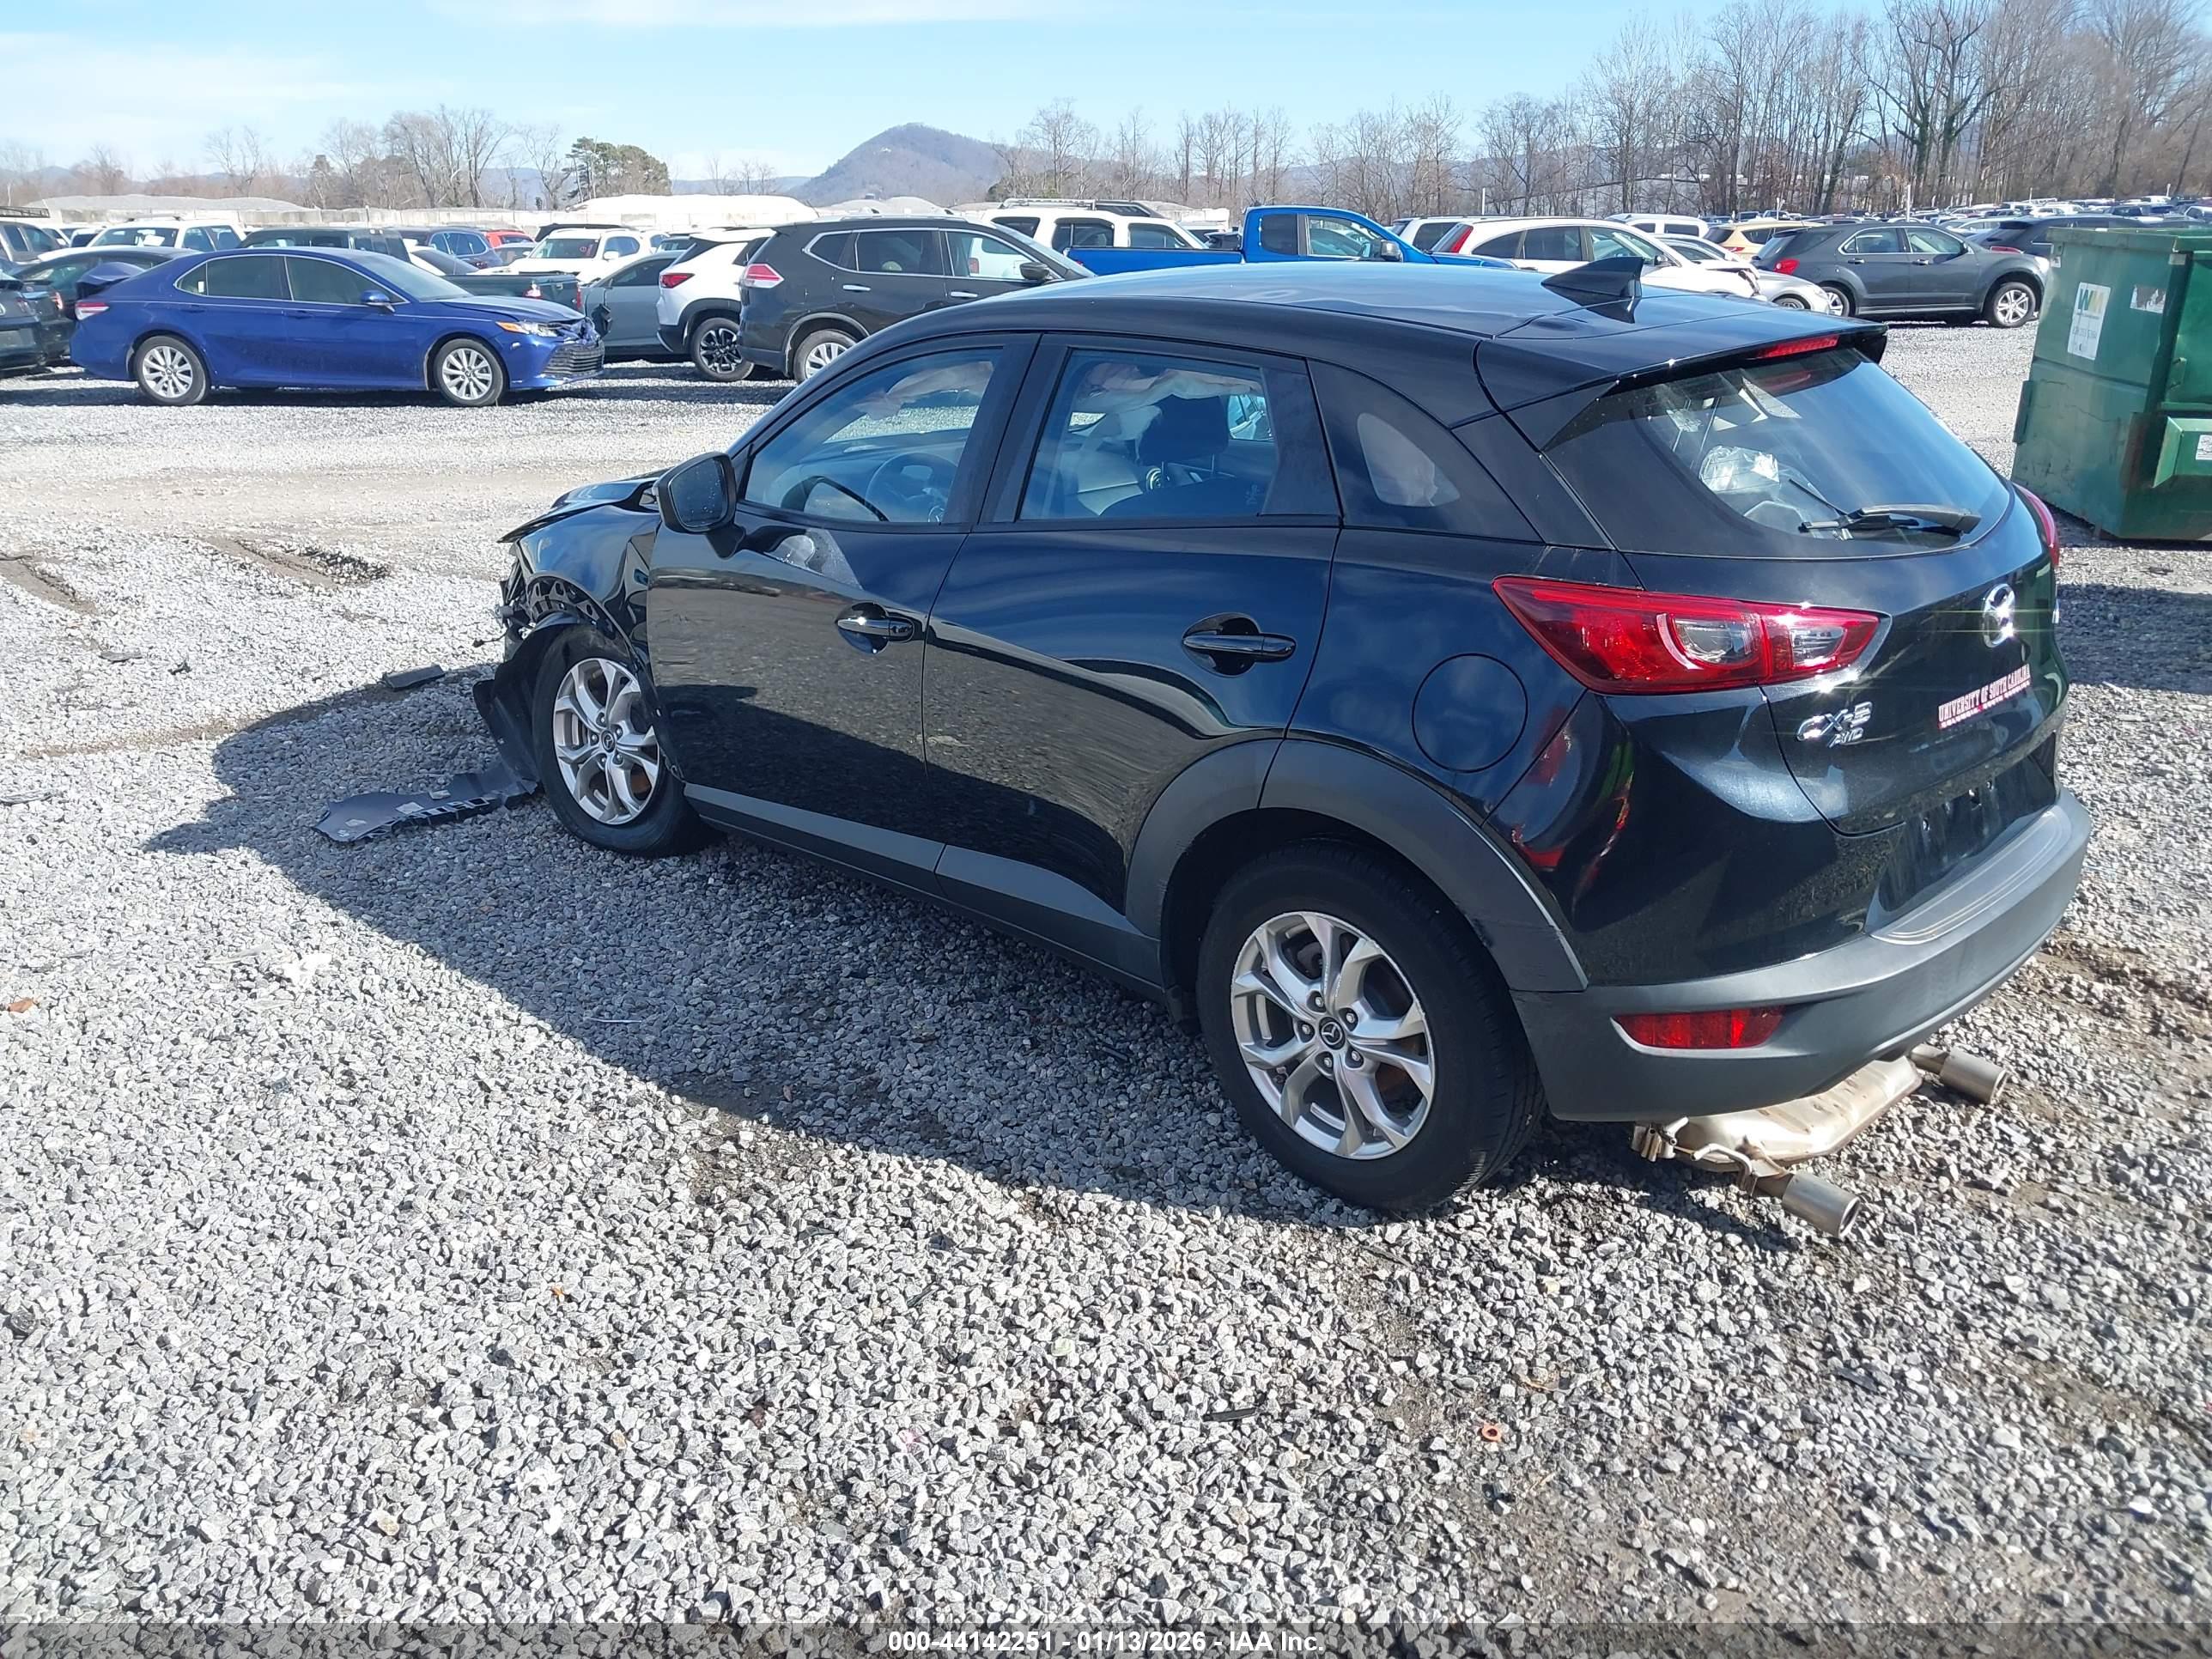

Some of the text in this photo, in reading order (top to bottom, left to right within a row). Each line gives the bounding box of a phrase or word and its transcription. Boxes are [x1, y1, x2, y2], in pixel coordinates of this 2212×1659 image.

[1938, 690, 1981, 722] UNIVERSITY
[1981, 685, 1989, 703] OF
[1990, 676, 2008, 700] SOUTH
[2008, 664, 2030, 690] CAROLINA
